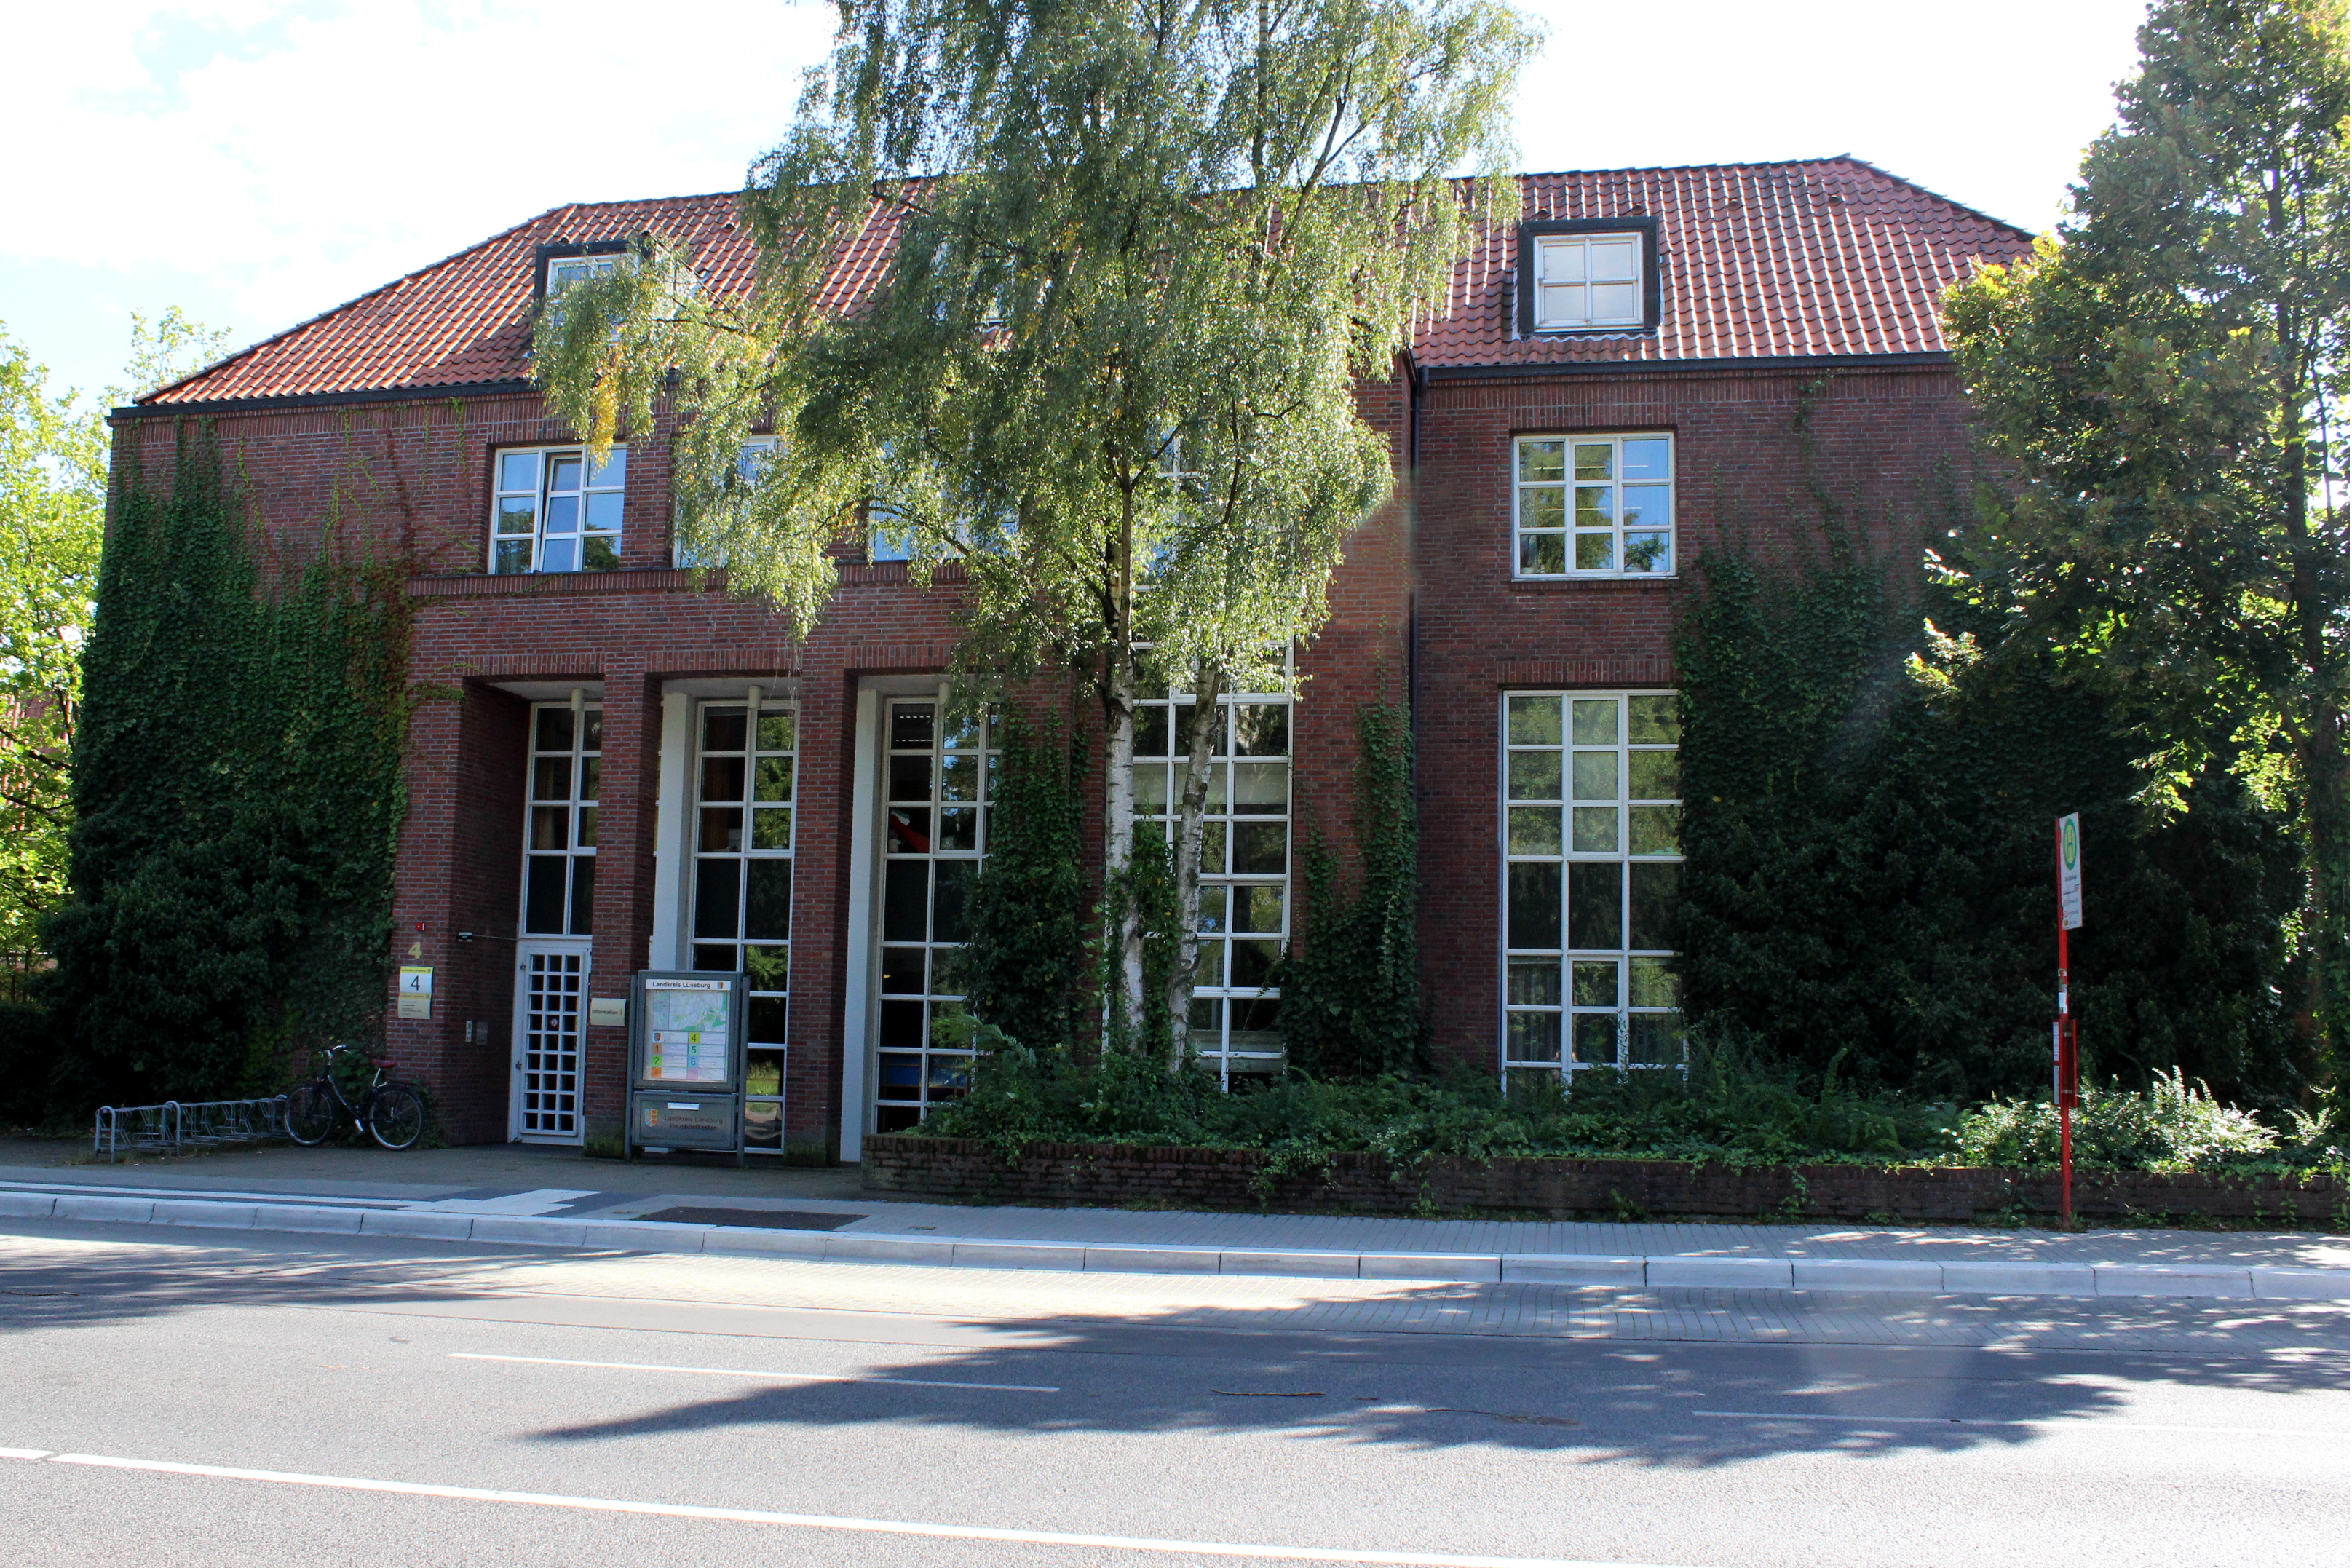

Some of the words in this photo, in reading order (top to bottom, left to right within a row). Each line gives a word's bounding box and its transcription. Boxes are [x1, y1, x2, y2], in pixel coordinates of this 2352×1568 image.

[408, 941, 422, 959] 4
[411, 975, 420, 991] 4
[691, 1034, 697, 1042] 4
[691, 1045, 697, 1054] 5
[654, 1057, 660, 1065] 2
[691, 1058, 696, 1066] 6
